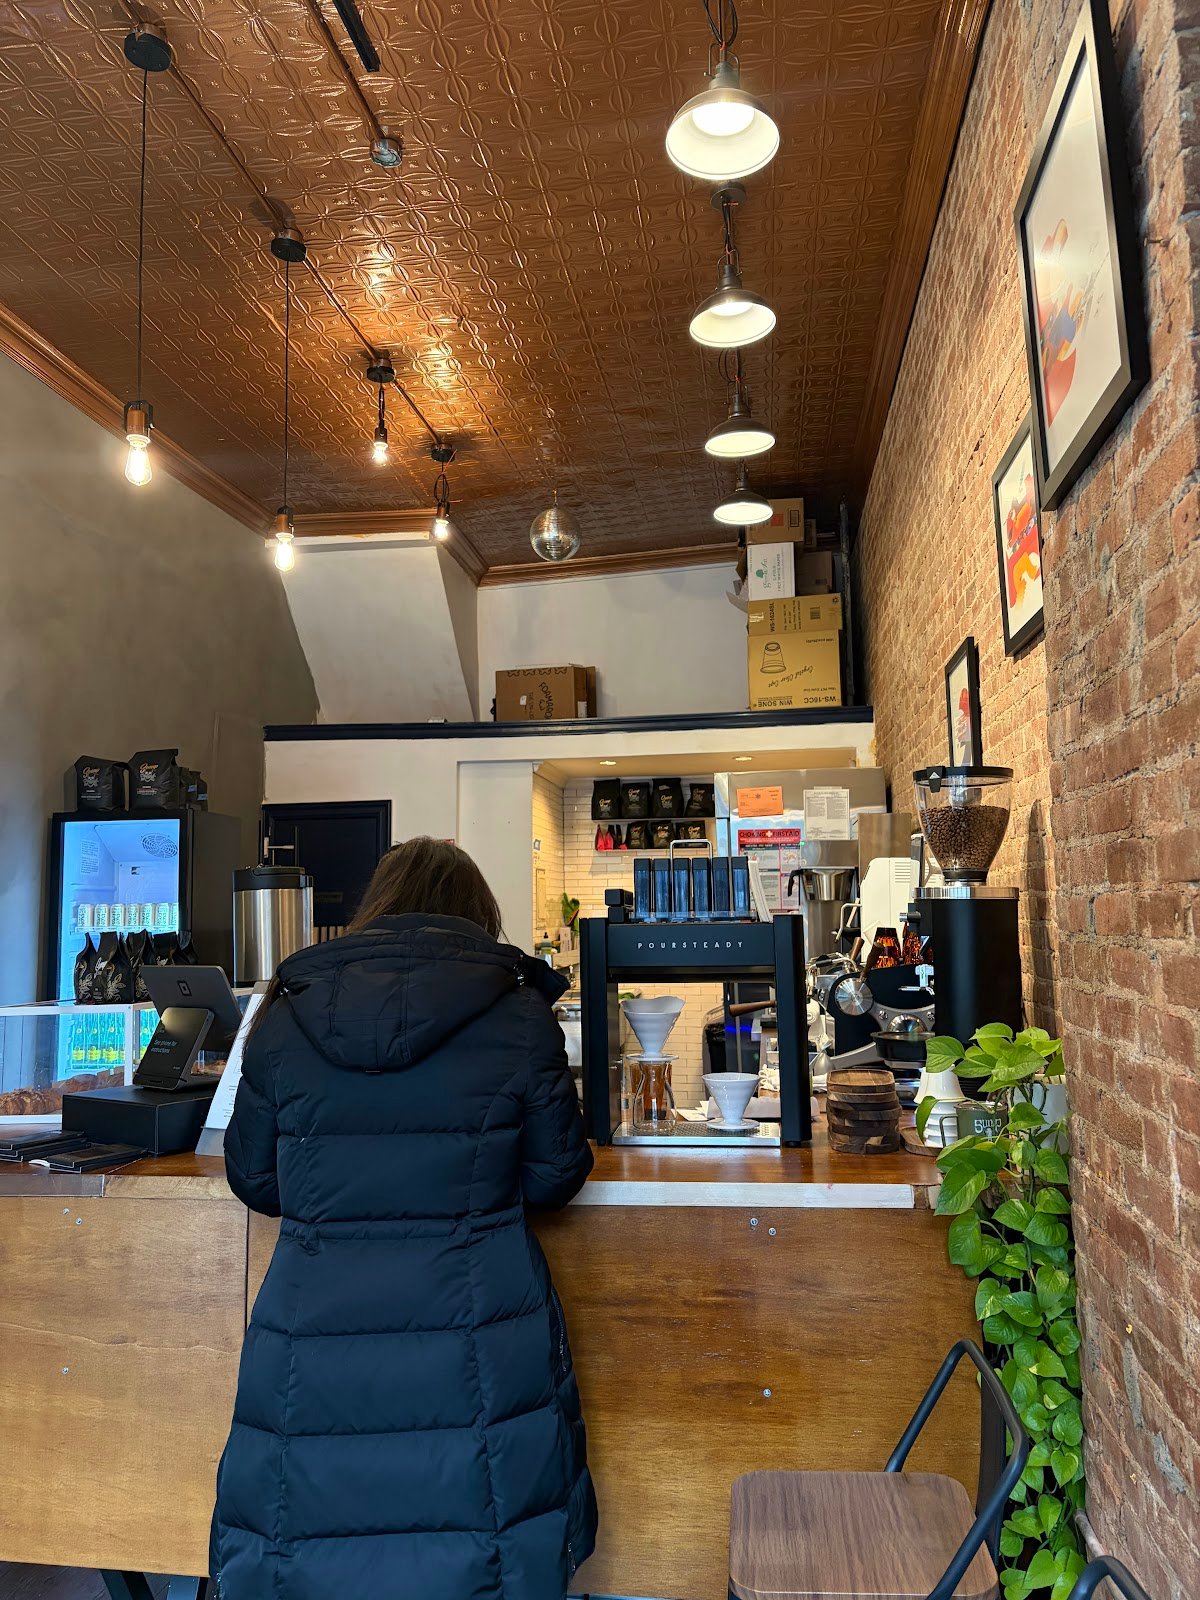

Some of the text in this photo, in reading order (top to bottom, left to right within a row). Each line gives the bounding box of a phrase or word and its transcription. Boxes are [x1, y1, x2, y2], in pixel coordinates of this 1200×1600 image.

[794, 665, 814, 679] Crystal
[781, 673, 794, 685] Clear
[758, 700, 777, 708] SONE
[803, 695, 837, 704] WS-16CC
[637, 941, 743, 949] POURSTEADY
